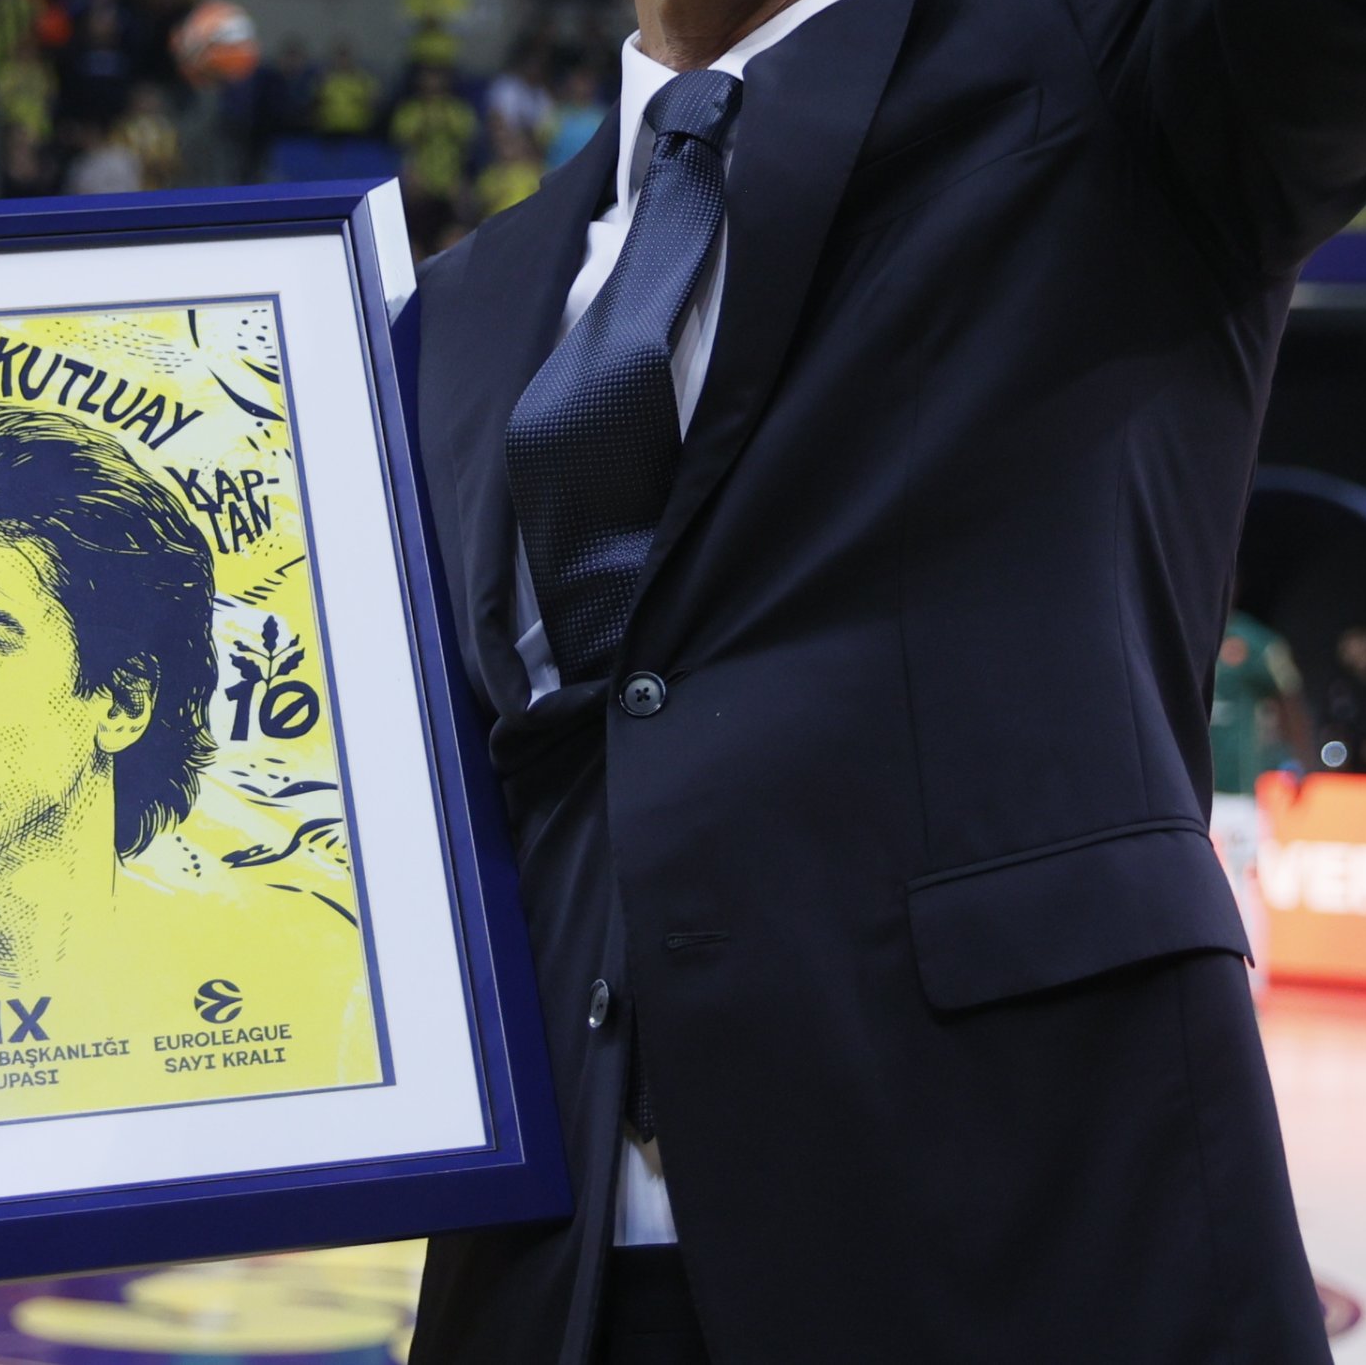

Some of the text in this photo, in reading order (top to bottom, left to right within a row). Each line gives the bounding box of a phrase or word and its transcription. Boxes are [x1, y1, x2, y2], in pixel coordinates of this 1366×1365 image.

[153, 1023, 293, 1052] EUROLEAGUE
[164, 1046, 287, 1074] SAYI KRALI
